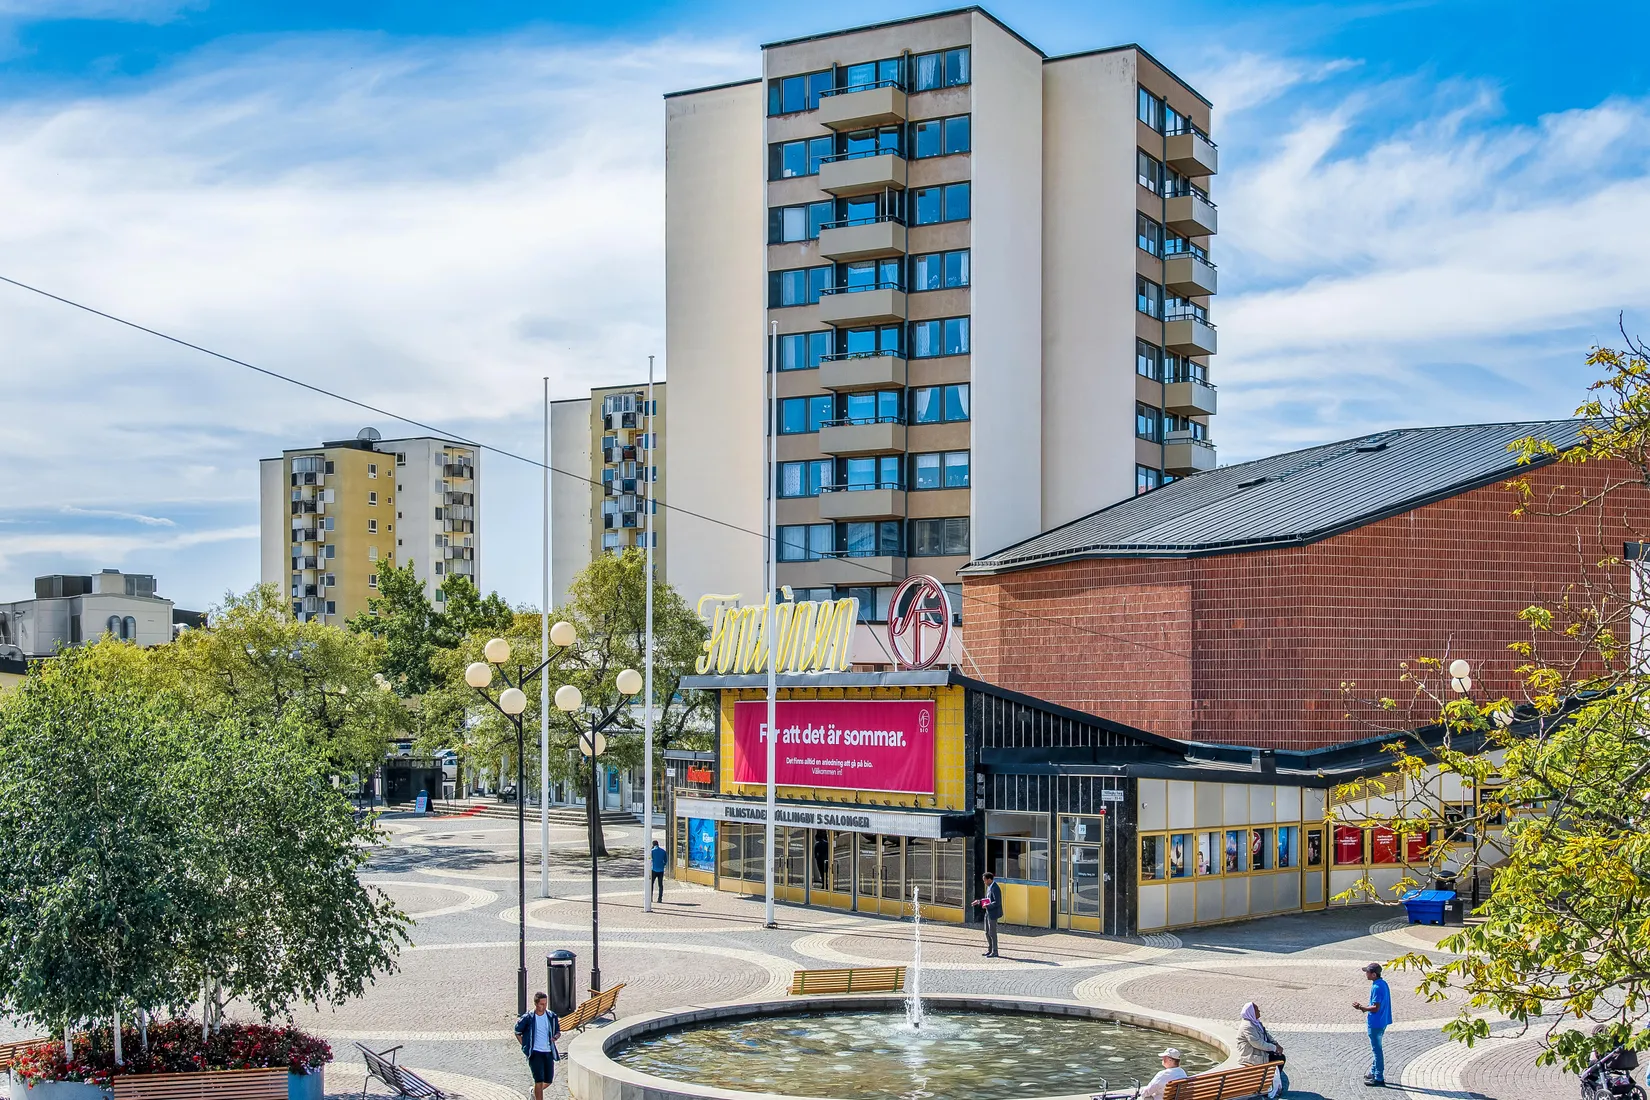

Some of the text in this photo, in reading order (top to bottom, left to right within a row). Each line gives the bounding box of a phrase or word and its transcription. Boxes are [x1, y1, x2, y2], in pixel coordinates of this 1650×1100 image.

[760, 723, 906, 747] Fr att det är sommar.
[822, 759, 843, 768] anledning
[851, 759, 856, 768] gå
[857, 760, 863, 768] på
[725, 807, 767, 820] FILMSTADE
[817, 814, 823, 824] 5
[824, 814, 870, 828] SALONGER
